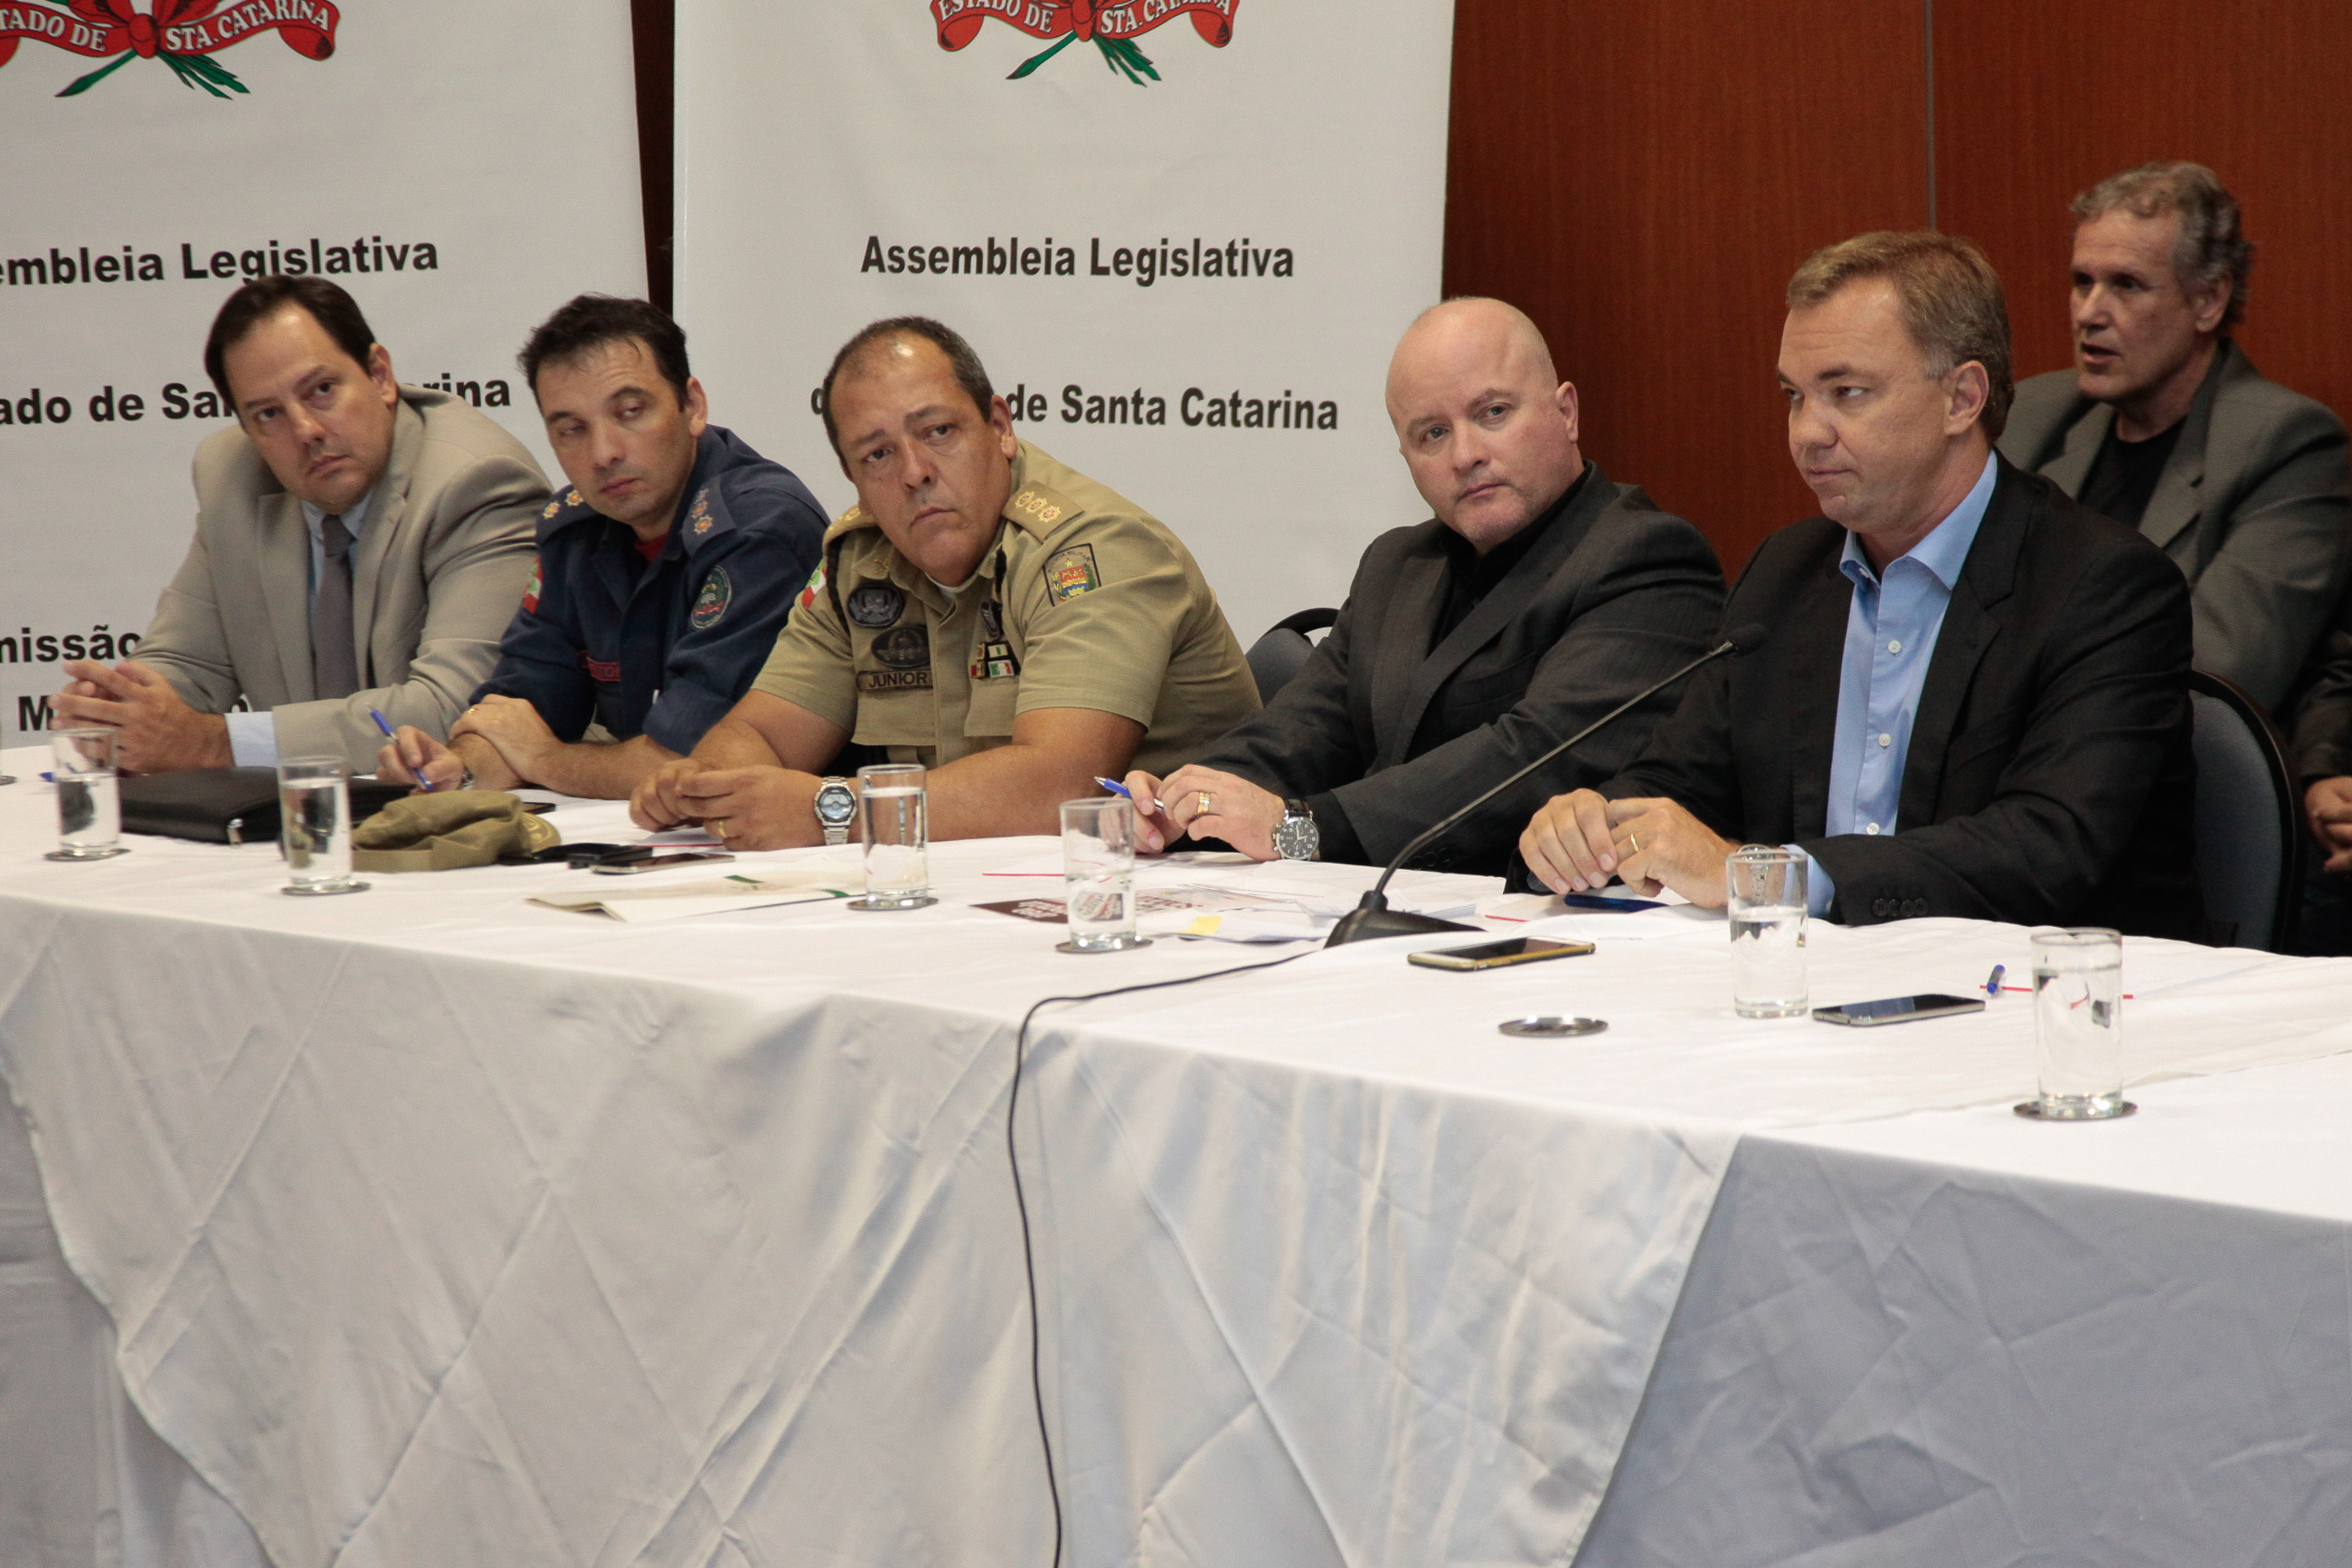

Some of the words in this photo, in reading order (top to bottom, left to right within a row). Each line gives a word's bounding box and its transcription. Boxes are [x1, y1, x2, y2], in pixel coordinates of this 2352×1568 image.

[69, 24, 107, 52] DE
[165, 24, 220, 51] STA.
[218, 0, 329, 39] CATARINA
[1024, 3, 1053, 33] DE
[0, 245, 164, 285] mbleia
[181, 235, 439, 286] Legislativa
[861, 235, 1076, 275] Assembleia
[1090, 238, 1294, 288] Legislativa
[89, 385, 144, 422] de
[1006, 383, 1047, 422] de
[1061, 384, 1167, 425] Santa
[1180, 386, 1338, 430] Catarina
[868, 672, 929, 687] JUNIOR
